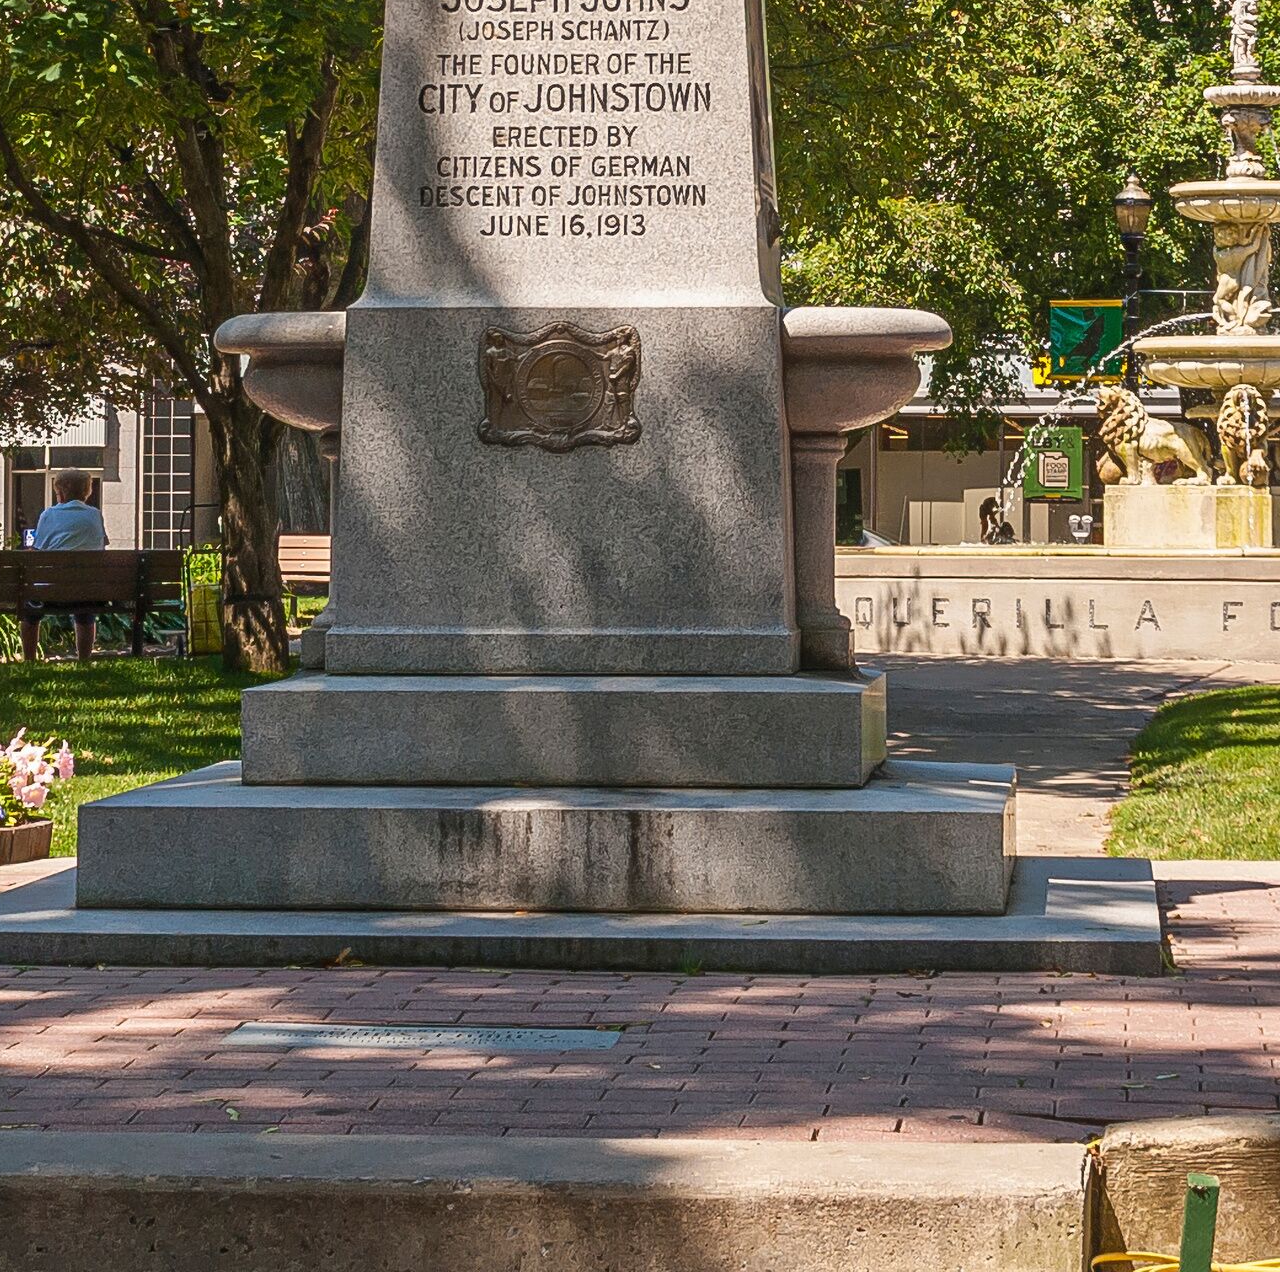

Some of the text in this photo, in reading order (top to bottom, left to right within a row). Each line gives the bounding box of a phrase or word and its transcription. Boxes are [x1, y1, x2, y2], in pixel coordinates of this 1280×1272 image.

[458, 19, 671, 42] (JOSEPH SCHANTZ)
[437, 52, 693, 76] THE FOUNDER OF THE
[419, 82, 712, 114] CITY OF JOHNSTOWN
[492, 126, 638, 148] ERECTED BY
[436, 155, 691, 178] CITIZENS OF GERMAN
[419, 184, 708, 208] DESCENT OF JOHNSTOWN
[479, 214, 550, 237] JUNE
